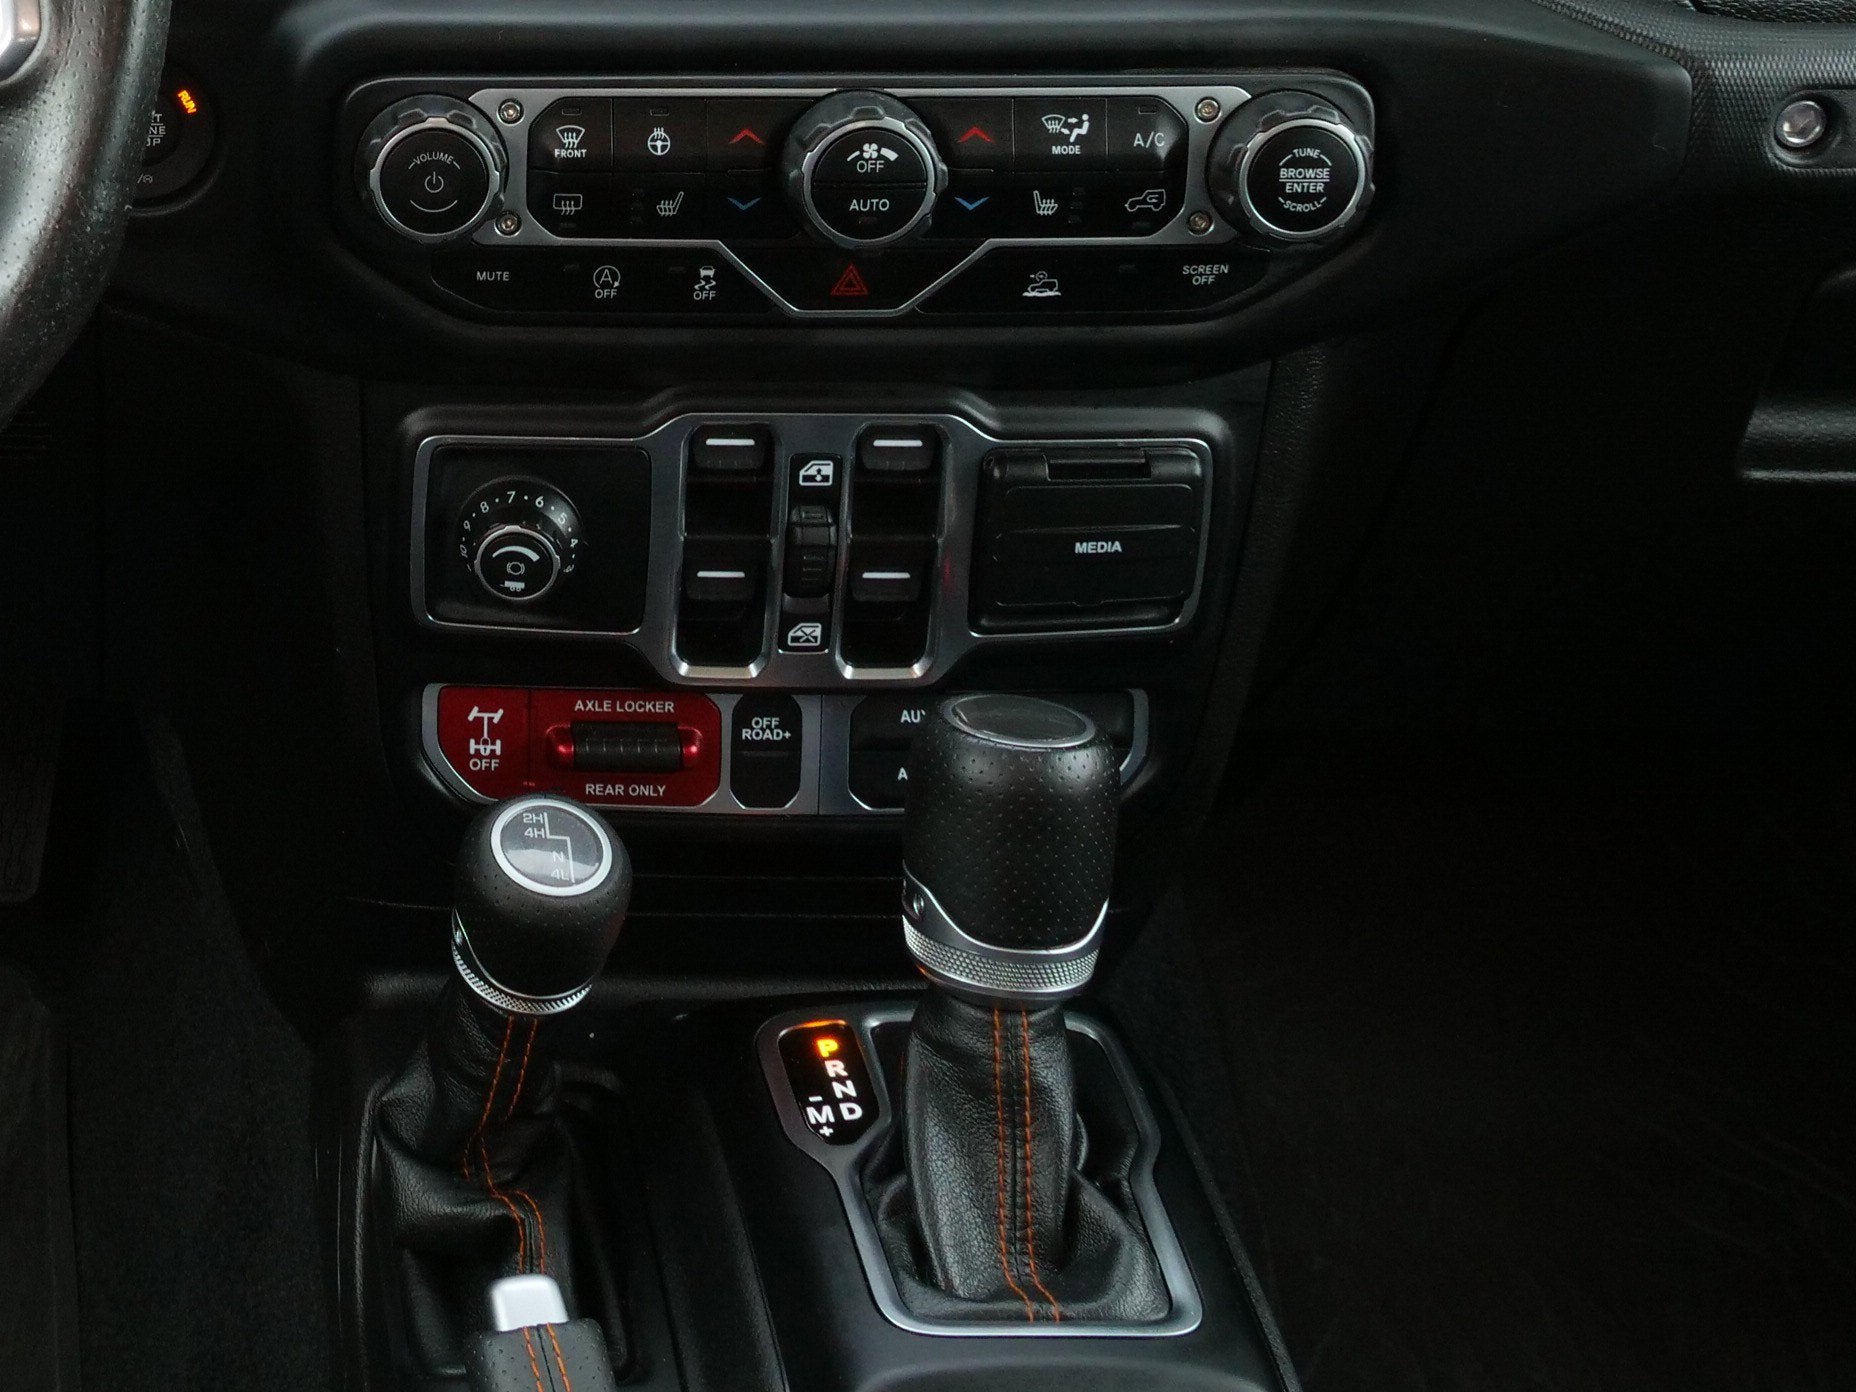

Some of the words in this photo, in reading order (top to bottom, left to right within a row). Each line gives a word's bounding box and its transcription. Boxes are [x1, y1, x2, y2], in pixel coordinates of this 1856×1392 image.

[177, 89, 198, 114] RUN
[1133, 131, 1166, 149] A/C
[554, 148, 587, 159] FRONT
[1051, 145, 1082, 155] MODE
[1292, 148, 1322, 160] TUNE
[413, 151, 455, 166] VOLUME
[856, 160, 884, 174] OFF
[1279, 167, 1330, 181] BROWSE
[1285, 182, 1325, 194] ENTER
[850, 198, 890, 212] AUTO
[1282, 198, 1322, 214] SCROLL
[476, 271, 510, 282] MUTE
[1182, 264, 1230, 276] SCREEN
[1192, 275, 1216, 286] OFF
[594, 289, 618, 300] OFF
[693, 290, 716, 301] OFF
[506, 490, 517, 504] 7
[535, 495, 545, 508] 6
[479, 501, 490, 514] 8
[1074, 540, 1123, 554] MEDIA
[574, 699, 612, 713] AXLE
[615, 700, 675, 714] LOCKER
[752, 717, 781, 729] OFF
[741, 728, 792, 741] ROAD+
[469, 759, 500, 772] OFF
[584, 783, 625, 796] REAR
[628, 783, 666, 797] ONLY
[523, 812, 544, 824] 2H
[524, 827, 545, 839] 4H
[817, 1038, 840, 1058] P
[824, 1060, 849, 1078] R
[831, 1080, 858, 1099] N
[806, 1105, 836, 1125] M
[839, 1102, 863, 1121] D
